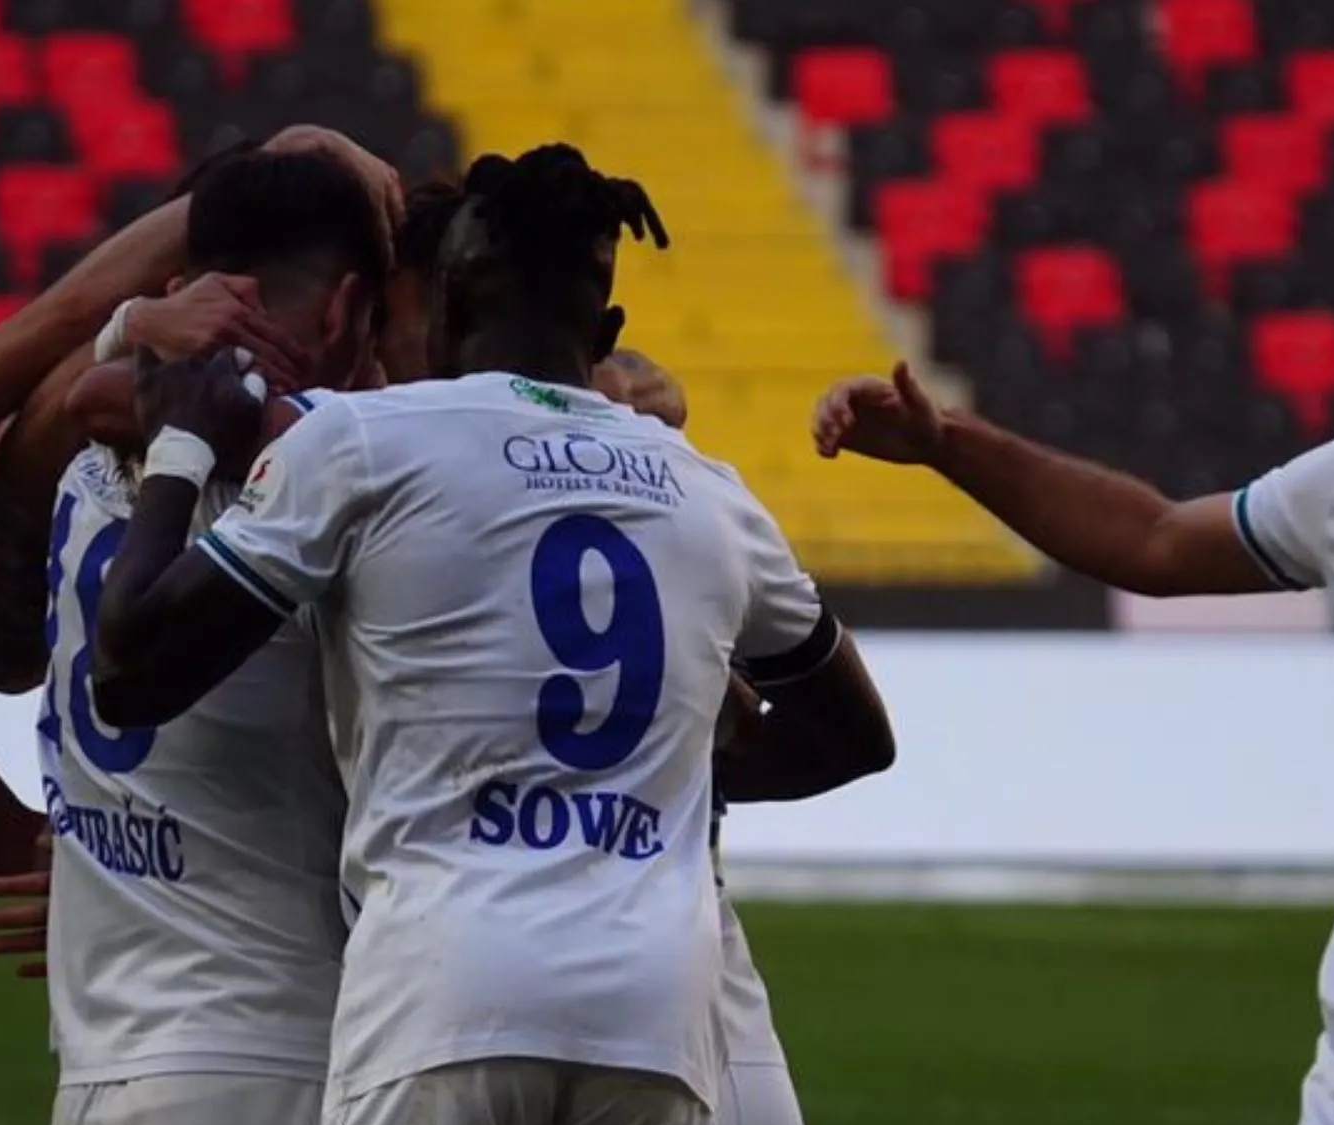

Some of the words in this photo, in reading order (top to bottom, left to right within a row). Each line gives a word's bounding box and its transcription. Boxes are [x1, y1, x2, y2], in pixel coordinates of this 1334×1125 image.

[503, 433, 685, 498] GLORIA
[531, 514, 665, 771] 9
[470, 780, 664, 860] SOWE
